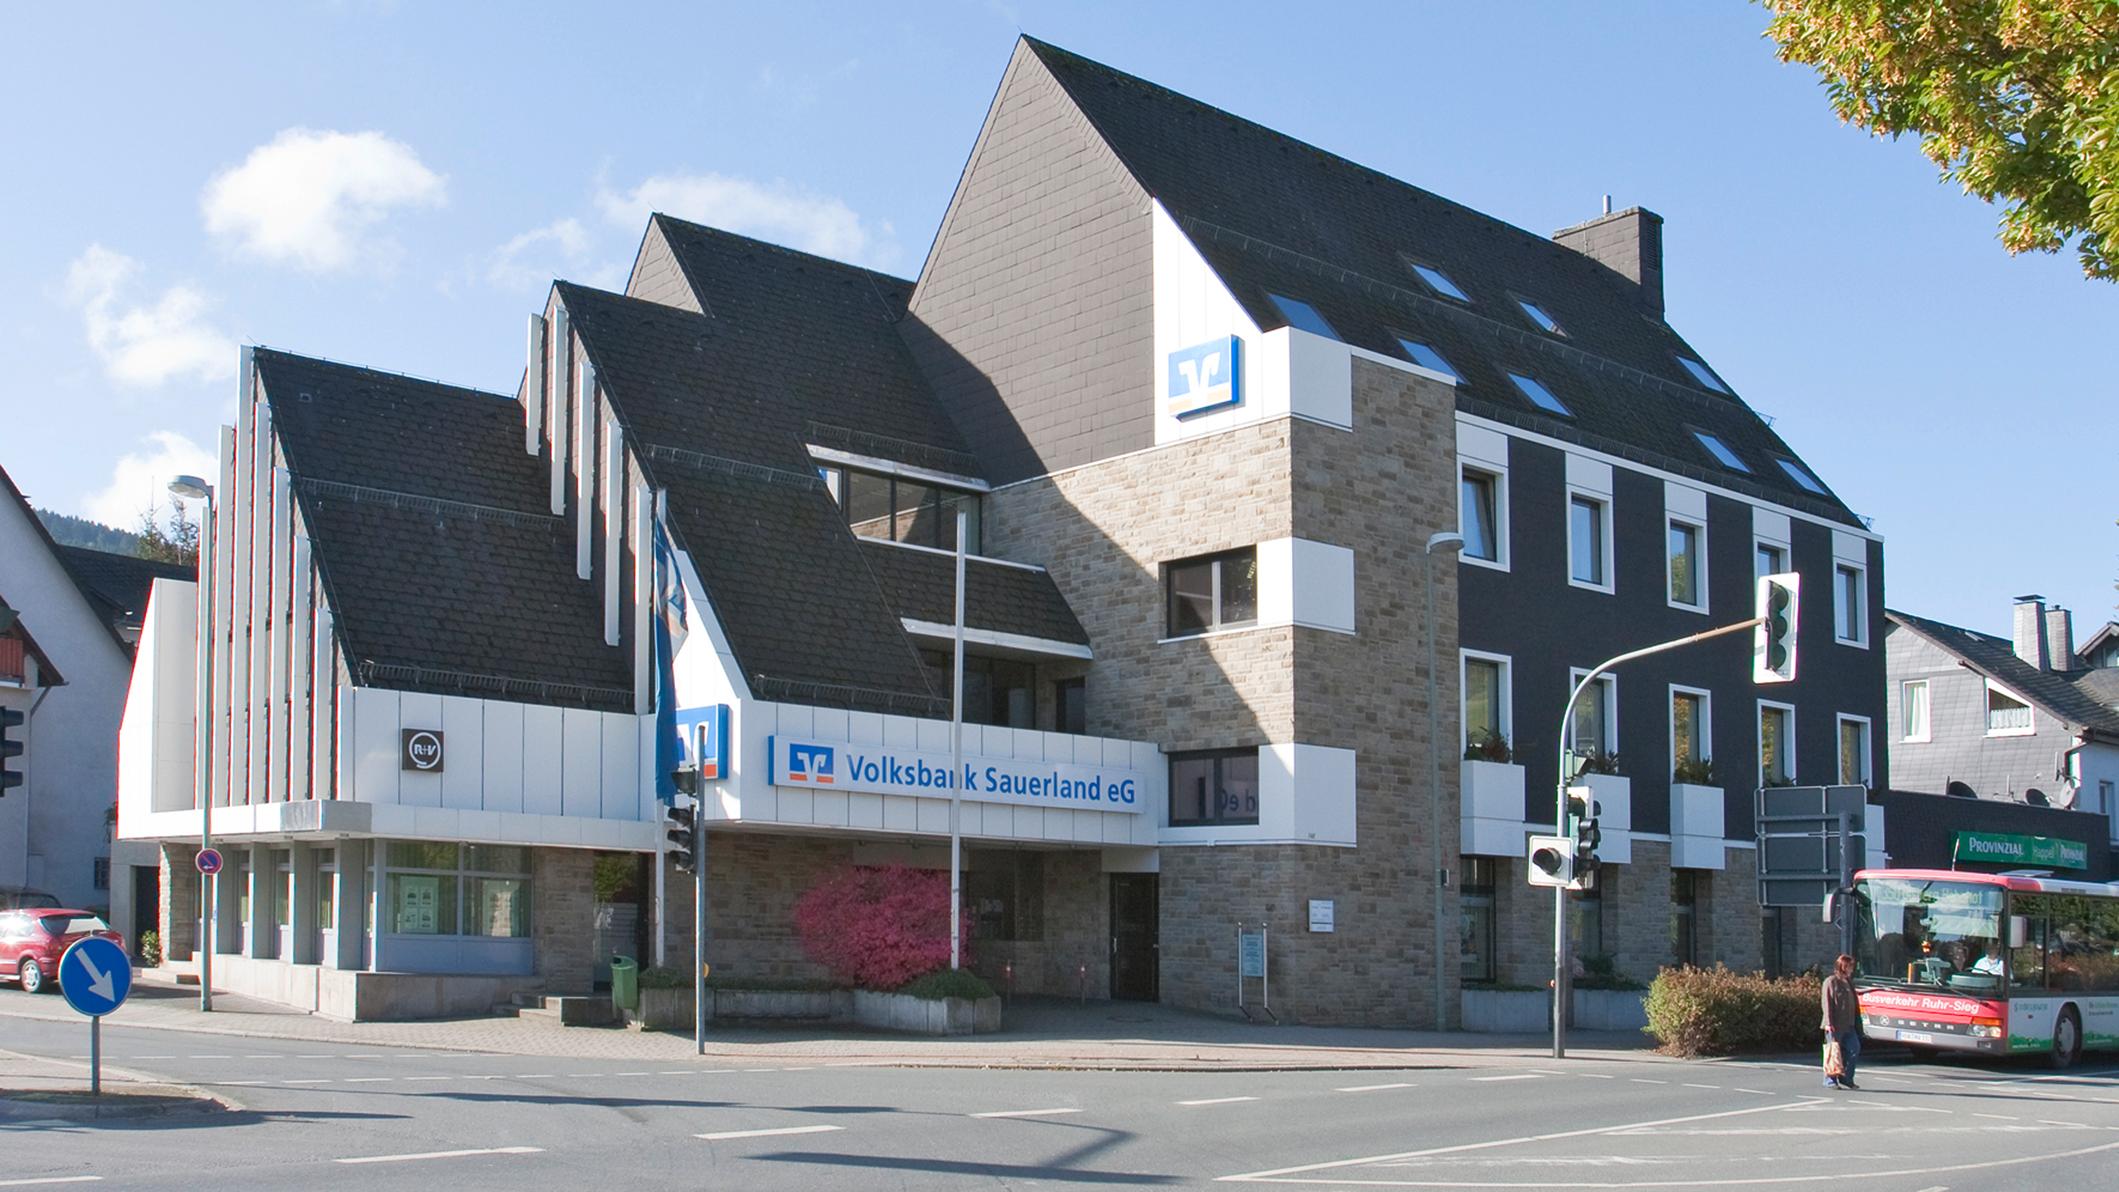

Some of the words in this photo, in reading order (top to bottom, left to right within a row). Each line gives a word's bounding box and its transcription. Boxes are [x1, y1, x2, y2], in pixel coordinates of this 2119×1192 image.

[414, 743, 437, 756] R+V
[846, 754, 978, 791] Volksbank
[985, 766, 1102, 802] Sauerland
[1107, 778, 1136, 804] eG
[1968, 836, 2024, 857] PROVINZIAL
[1861, 992, 1919, 1007] Busverkehr
[1921, 997, 1980, 1015] Ruhr-Sieg
